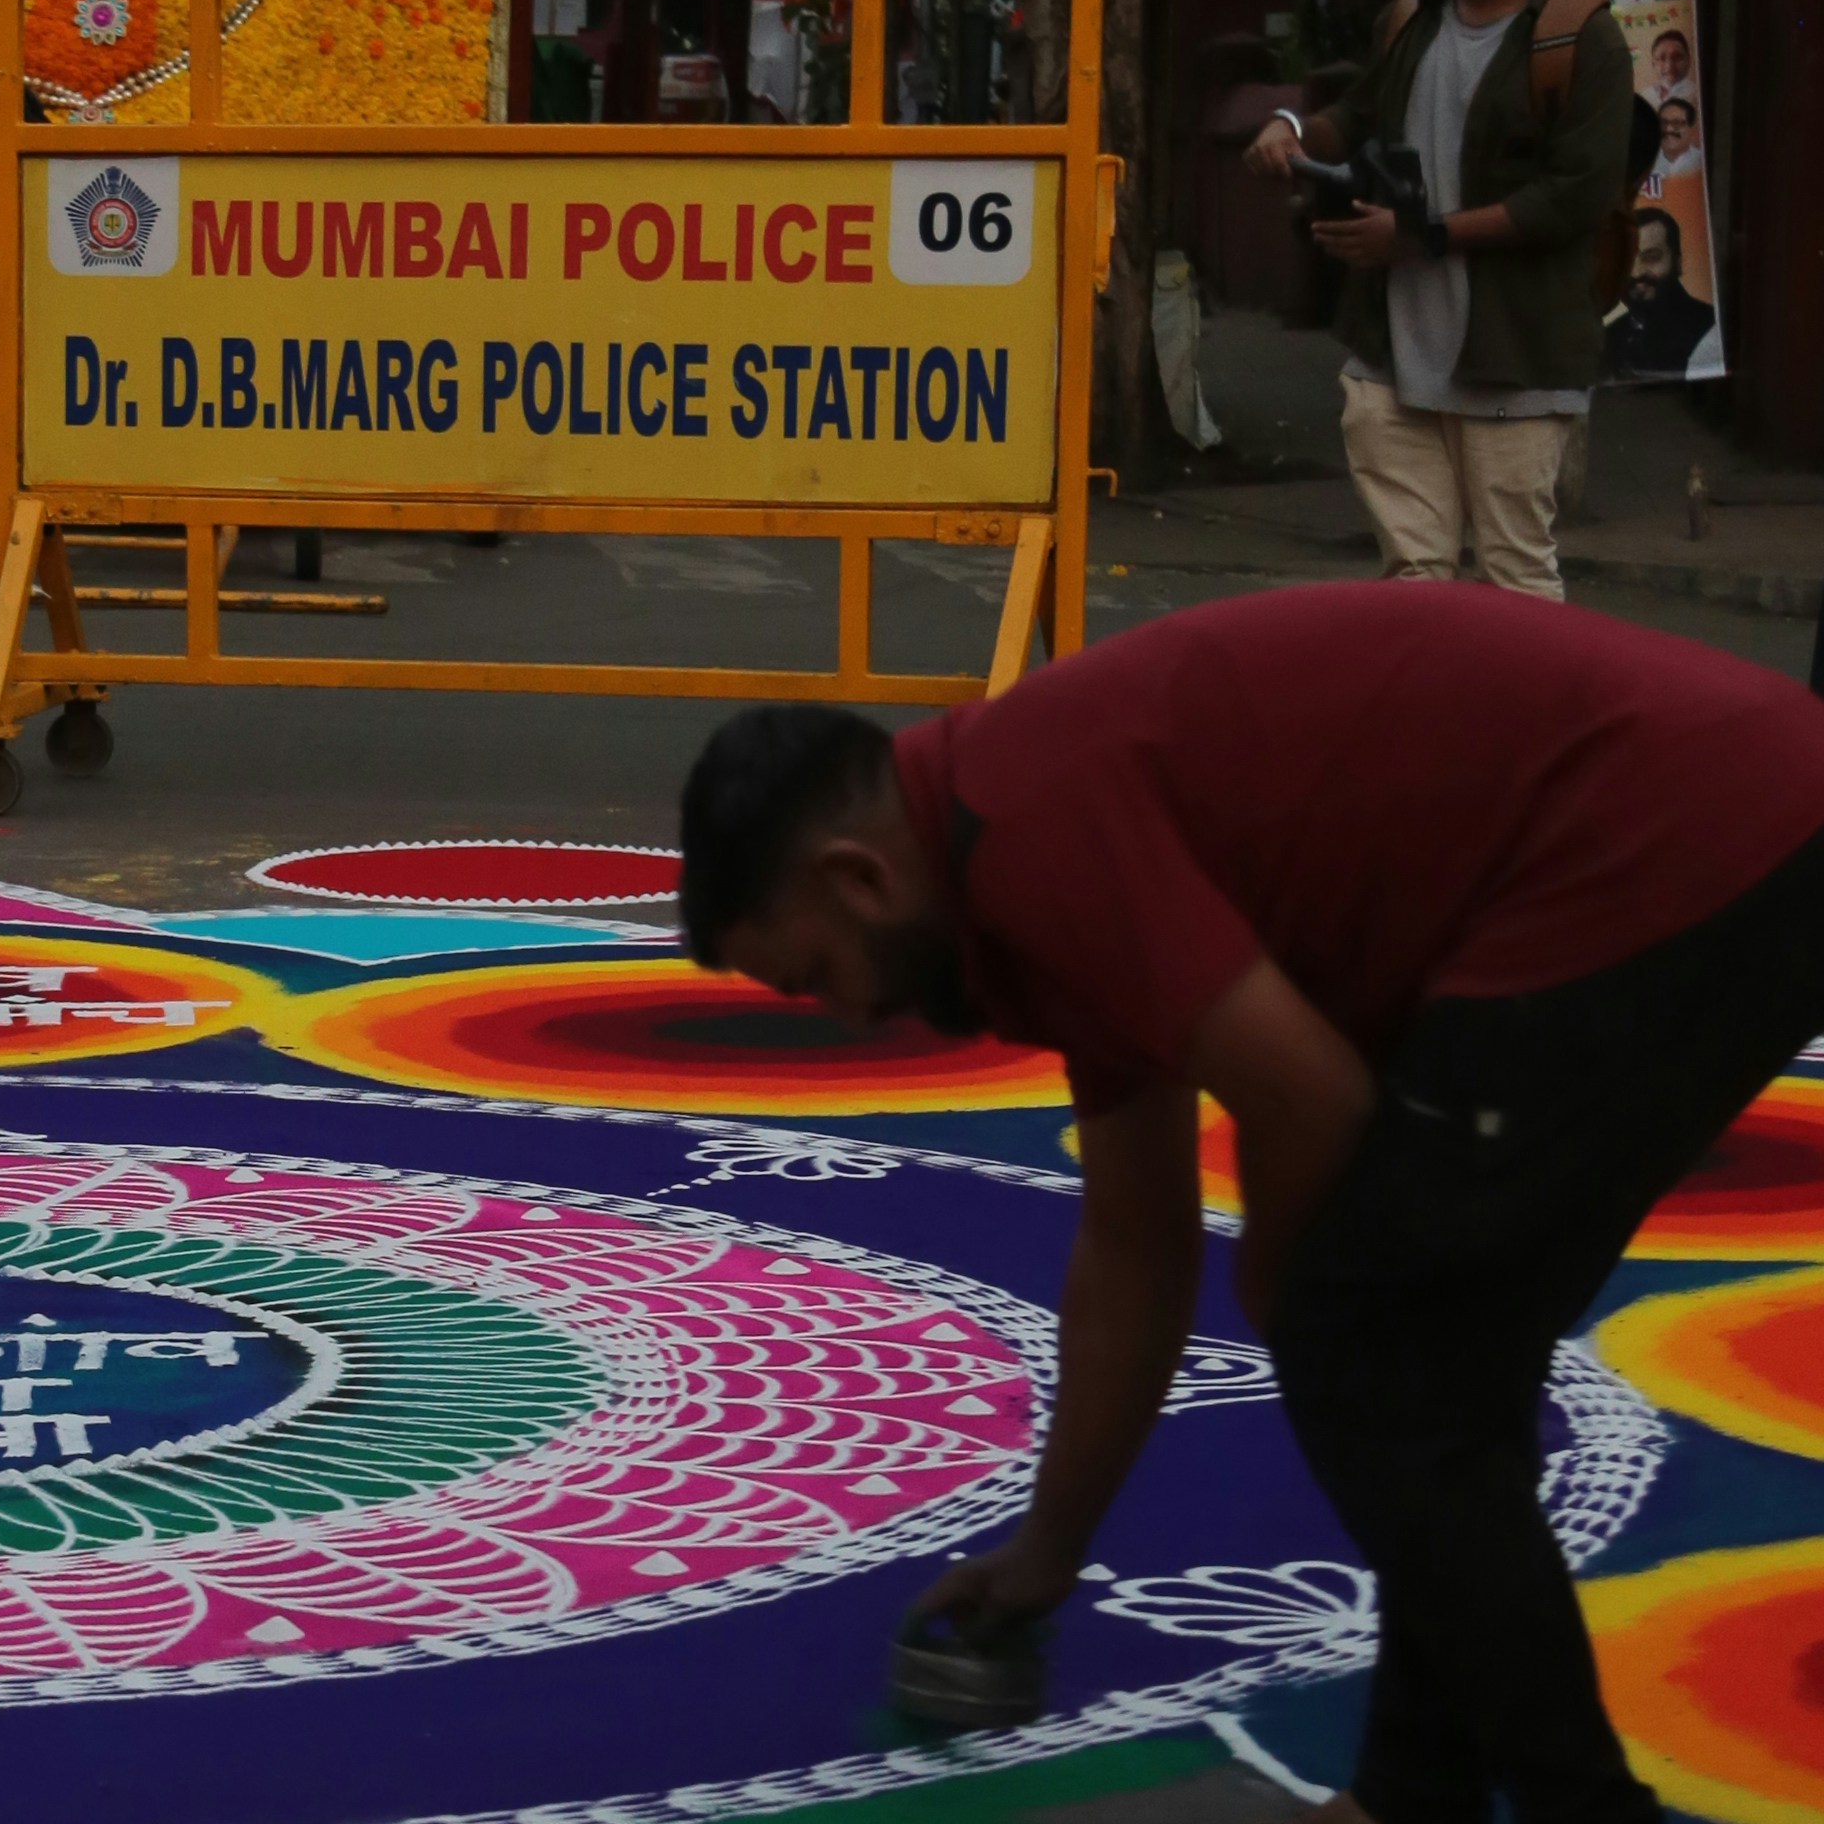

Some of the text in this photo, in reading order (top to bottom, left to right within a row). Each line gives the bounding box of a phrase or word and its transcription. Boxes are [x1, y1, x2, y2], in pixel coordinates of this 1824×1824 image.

[190, 199, 876, 284] MUMBAI POLICE
[917, 192, 1014, 253] 06
[63, 335, 137, 427] Dr.
[483, 341, 709, 438] POLICE
[730, 345, 1009, 443] STATION
